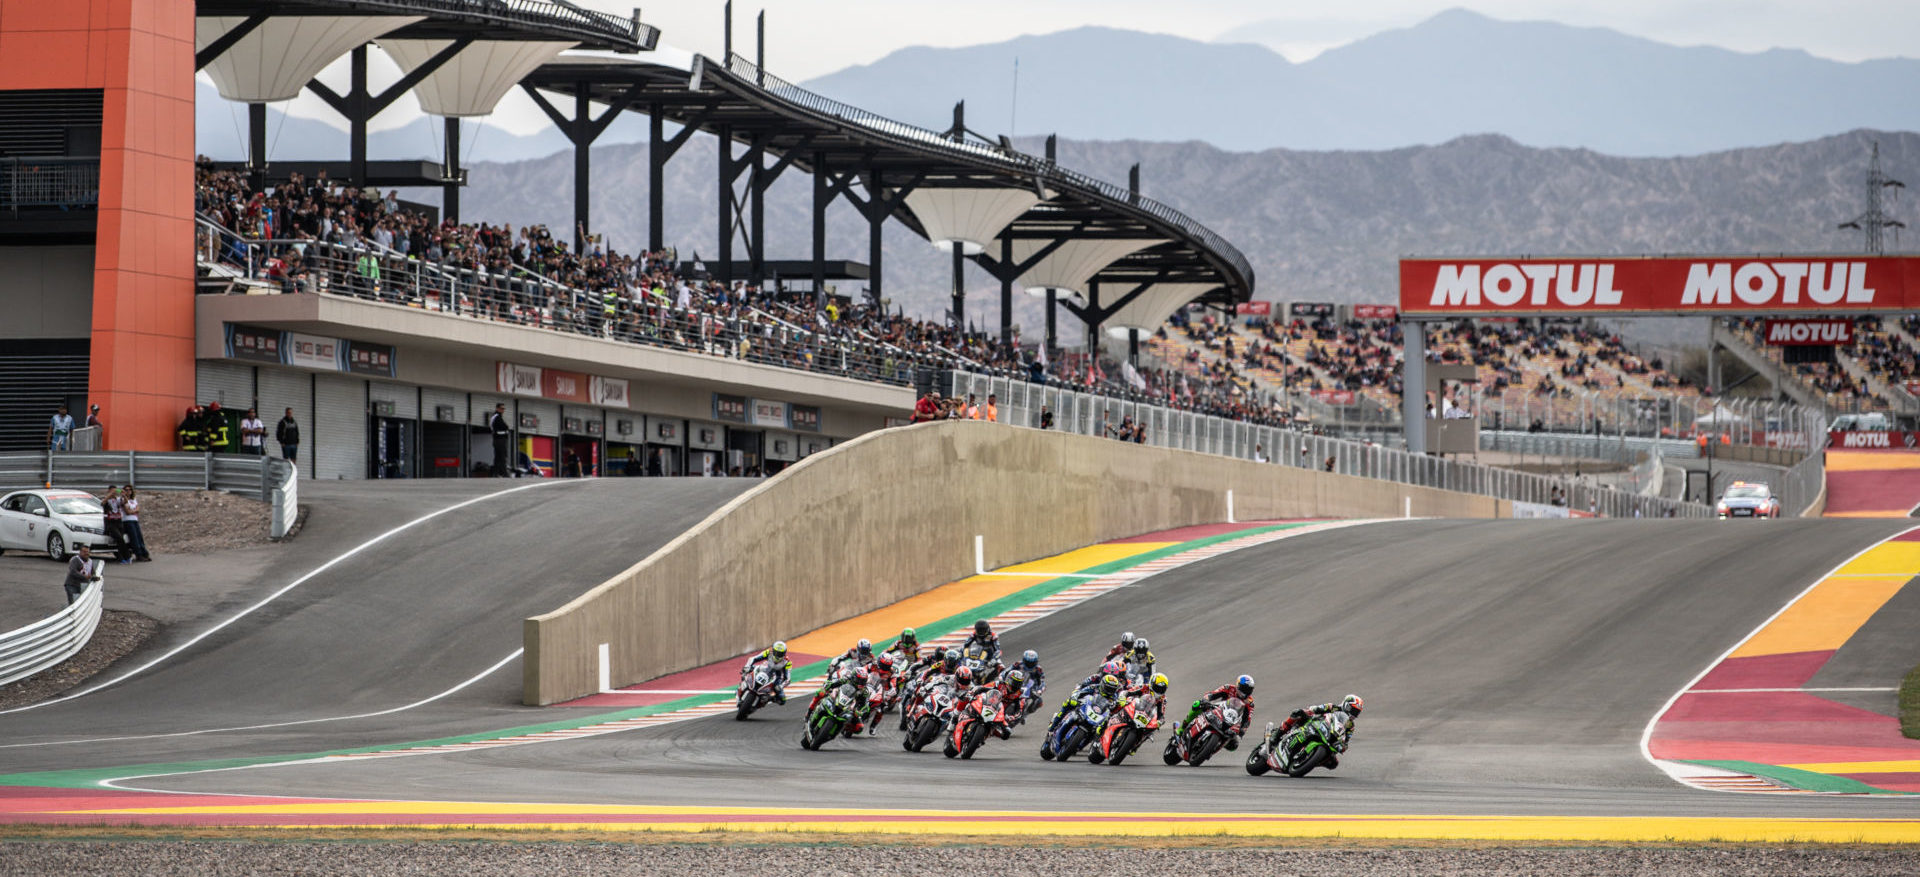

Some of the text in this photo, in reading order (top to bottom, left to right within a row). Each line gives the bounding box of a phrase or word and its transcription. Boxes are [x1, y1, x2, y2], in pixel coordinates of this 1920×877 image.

[1429, 263, 1624, 306] MOTUL
[1680, 262, 1876, 305] MOTUL
[1769, 322, 1849, 341] MOTUL
[1844, 432, 1890, 447] MOTUL
[984, 709, 994, 717] 7
[1088, 711, 1099, 721] 11
